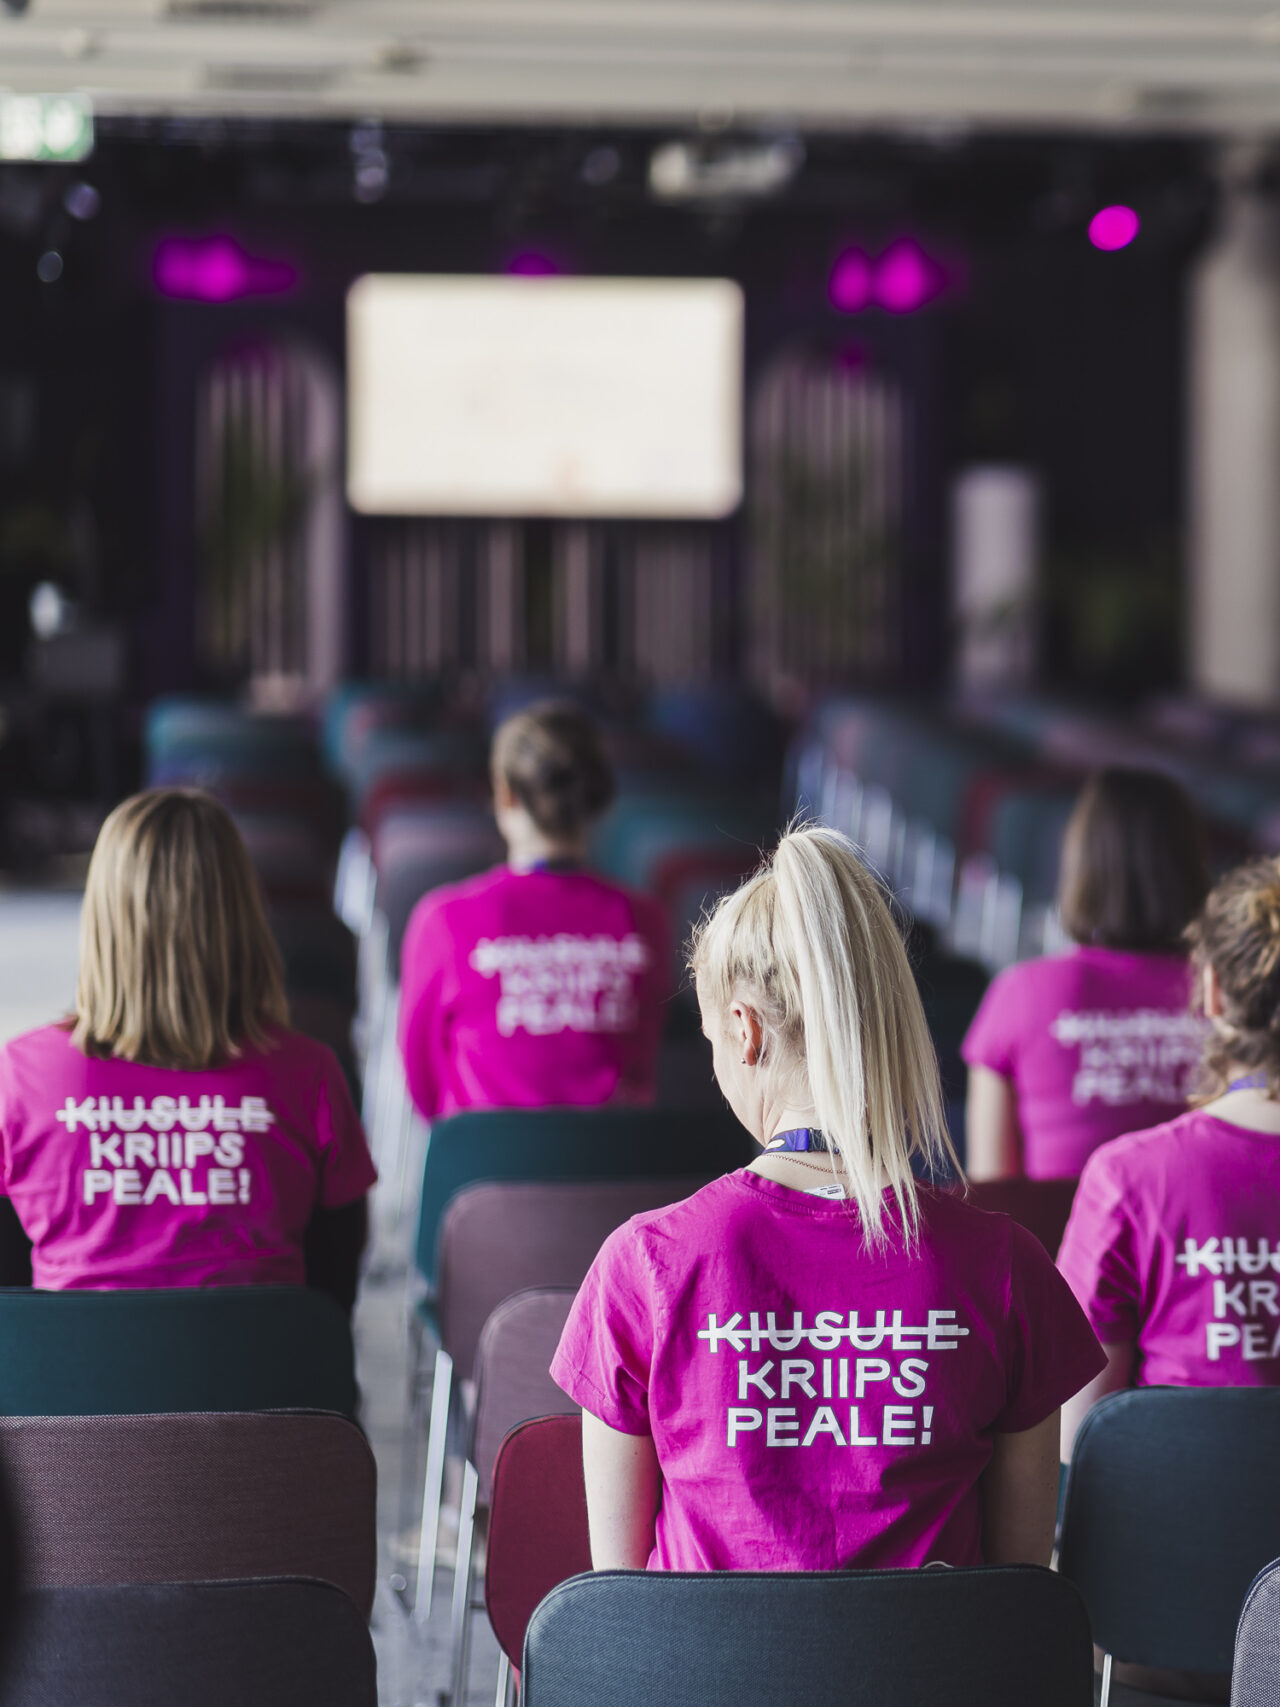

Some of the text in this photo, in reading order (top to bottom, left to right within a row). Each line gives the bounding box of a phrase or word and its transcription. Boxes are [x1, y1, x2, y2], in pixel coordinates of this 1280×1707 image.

[61, 1094, 271, 1132] KIUSULE
[89, 1132, 246, 1169] KRIIPS
[82, 1168, 252, 1206] PEALE!
[705, 1310, 960, 1354] KIUSULE
[737, 1357, 930, 1400] KRIIPS
[726, 1405, 935, 1448] PEALE!
